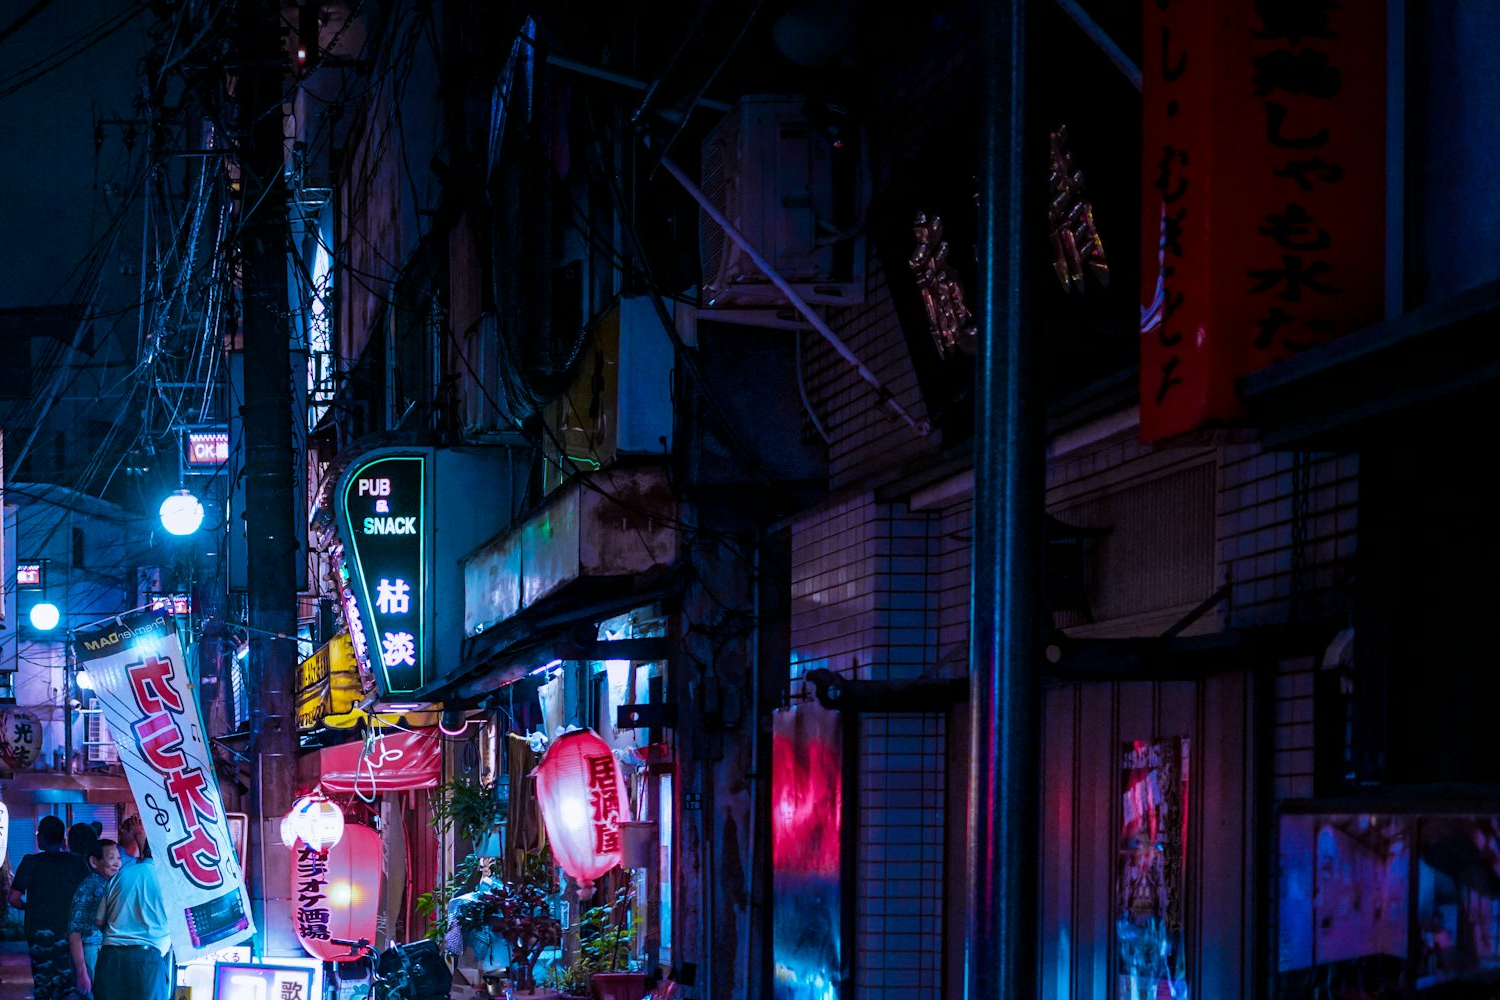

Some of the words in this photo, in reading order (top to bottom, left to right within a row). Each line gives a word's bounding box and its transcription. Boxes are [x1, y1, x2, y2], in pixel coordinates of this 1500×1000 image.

[359, 479, 390, 496] PUB
[376, 500, 388, 512] &
[364, 517, 416, 534] SNACK
[376, 579, 416, 667] 枯淡
[586, 756, 620, 854] 居酒屋
